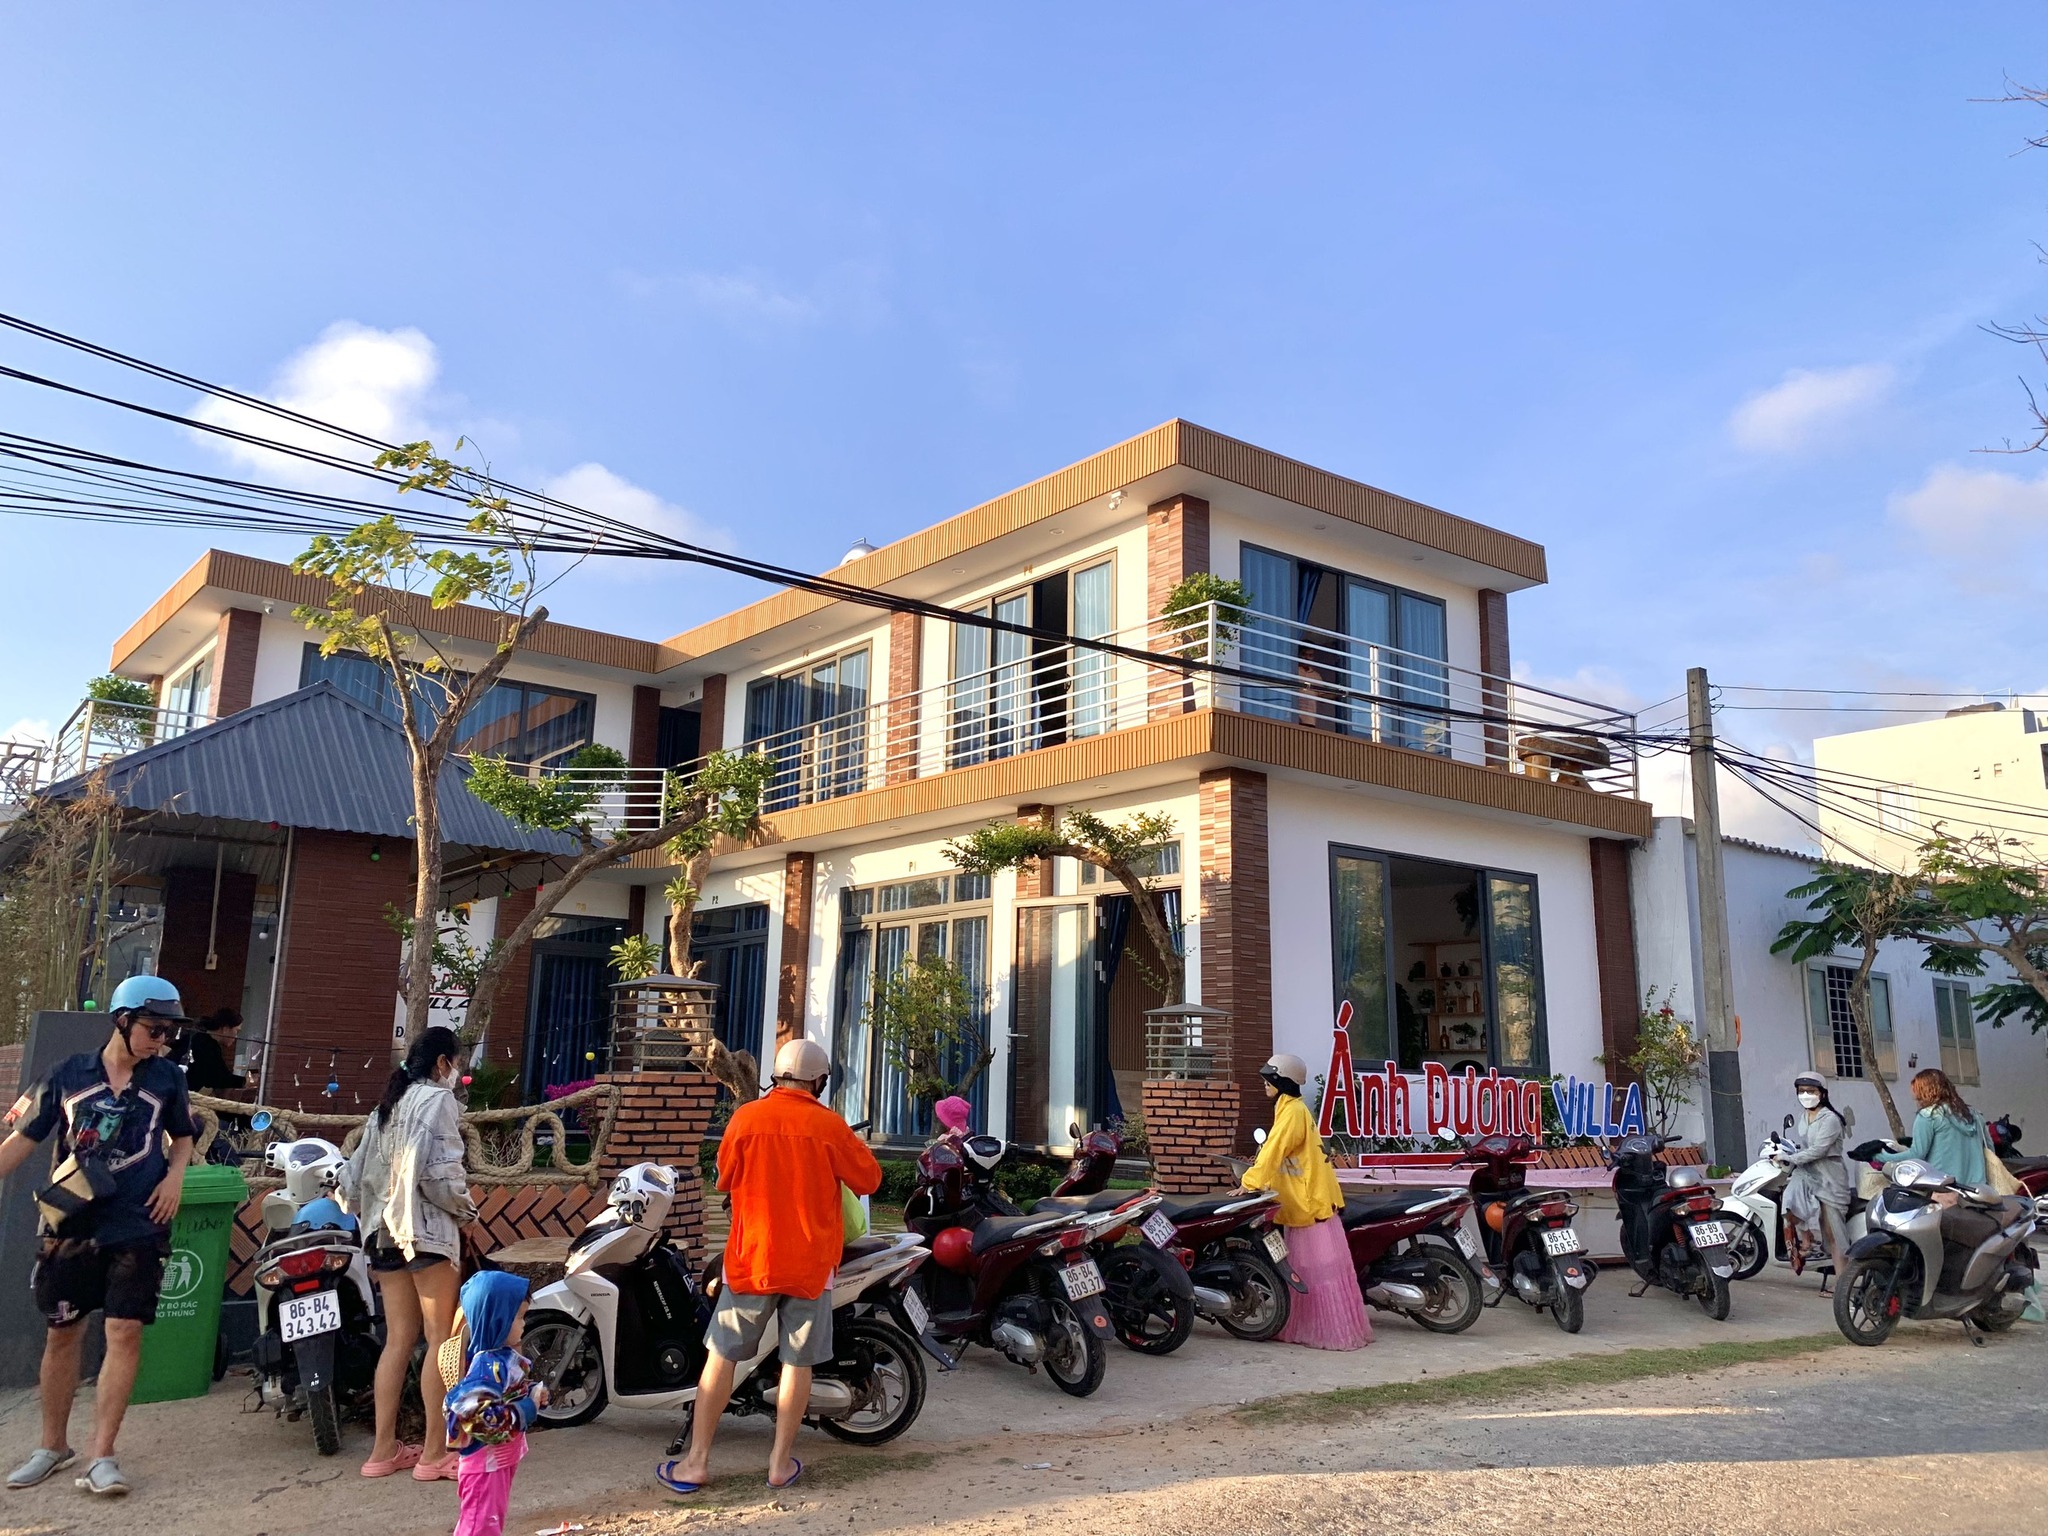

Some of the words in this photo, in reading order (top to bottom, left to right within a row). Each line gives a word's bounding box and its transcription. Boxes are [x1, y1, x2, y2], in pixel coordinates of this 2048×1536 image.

[1318, 1000, 1414, 1138] Ánh
[1551, 1074, 1646, 1138] VILLA
[1144, 1214, 1165, 1235] 86-B3
[1151, 1222, 1175, 1246] 423.20
[1694, 1222, 1719, 1236] 86-B9
[1547, 1230, 1572, 1244] 86-C1
[1547, 1239, 1580, 1255] 768.55
[1695, 1232, 1726, 1247] 093.39
[1065, 1263, 1094, 1283] 86-B4
[1067, 1276, 1101, 1299] 309.37
[289, 1296, 330, 1320] 86-B4
[286, 1312, 337, 1338] 343.42
